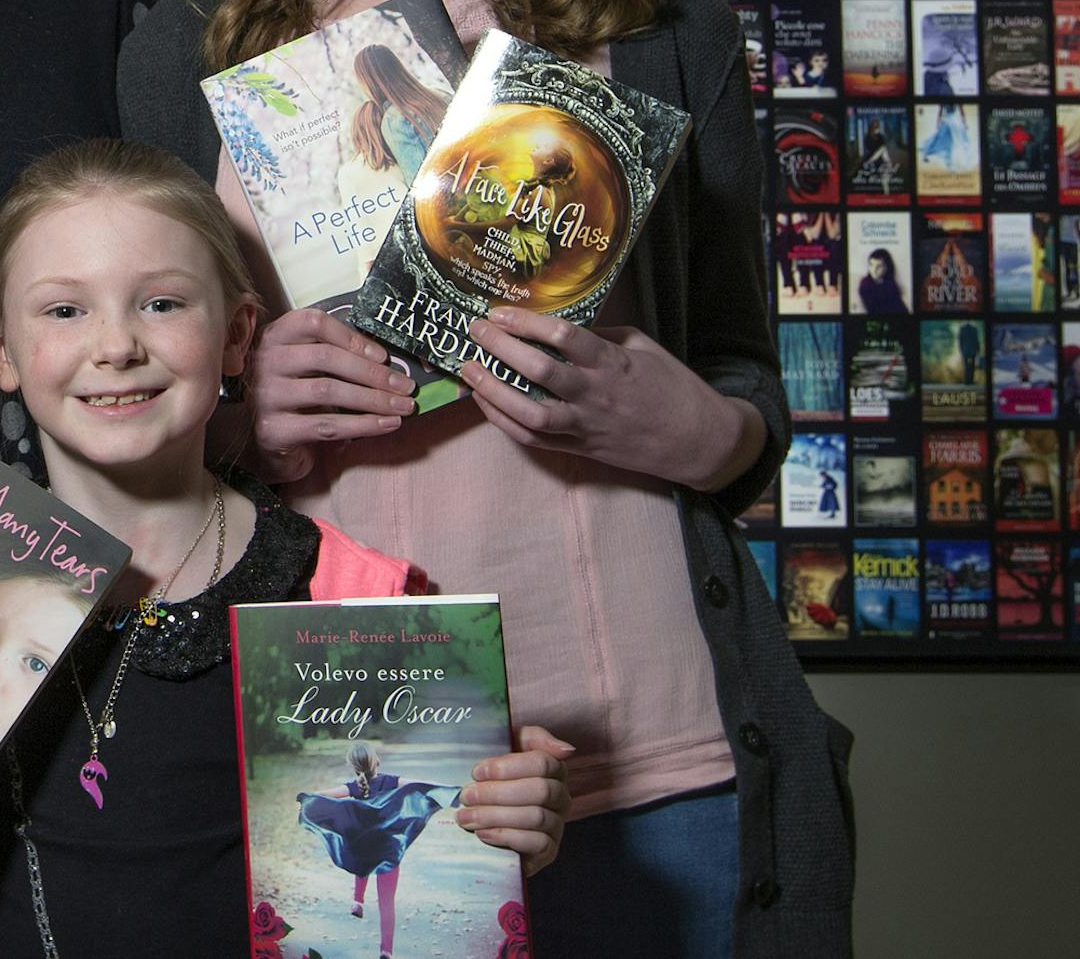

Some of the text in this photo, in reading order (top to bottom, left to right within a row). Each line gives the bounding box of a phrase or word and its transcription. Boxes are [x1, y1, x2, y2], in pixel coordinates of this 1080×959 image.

[272, 108, 340, 143] What if perfect
[280, 120, 341, 154] isn't possible?
[293, 186, 400, 245] A Perfect
[438, 152, 612, 254] A Face Like Glass
[330, 222, 377, 257] Life
[482, 236, 517, 260] THIEF,
[486, 225, 522, 248] CHILD,
[472, 244, 517, 273] MADMAN,
[481, 260, 503, 278] SPY,
[449, 255, 532, 300] which speaks the truth
[464, 271, 488, 292] which
[488, 283, 503, 297] one
[503, 288, 523, 304] lies?
[928, 285, 977, 303] RIVER
[39, 515, 108, 595] Tears
[853, 553, 919, 578] Kernick
[401, 628, 452, 644] Lavoie
[294, 662, 446, 682] Volevo essere
[277, 684, 473, 740] Lady Oscar
